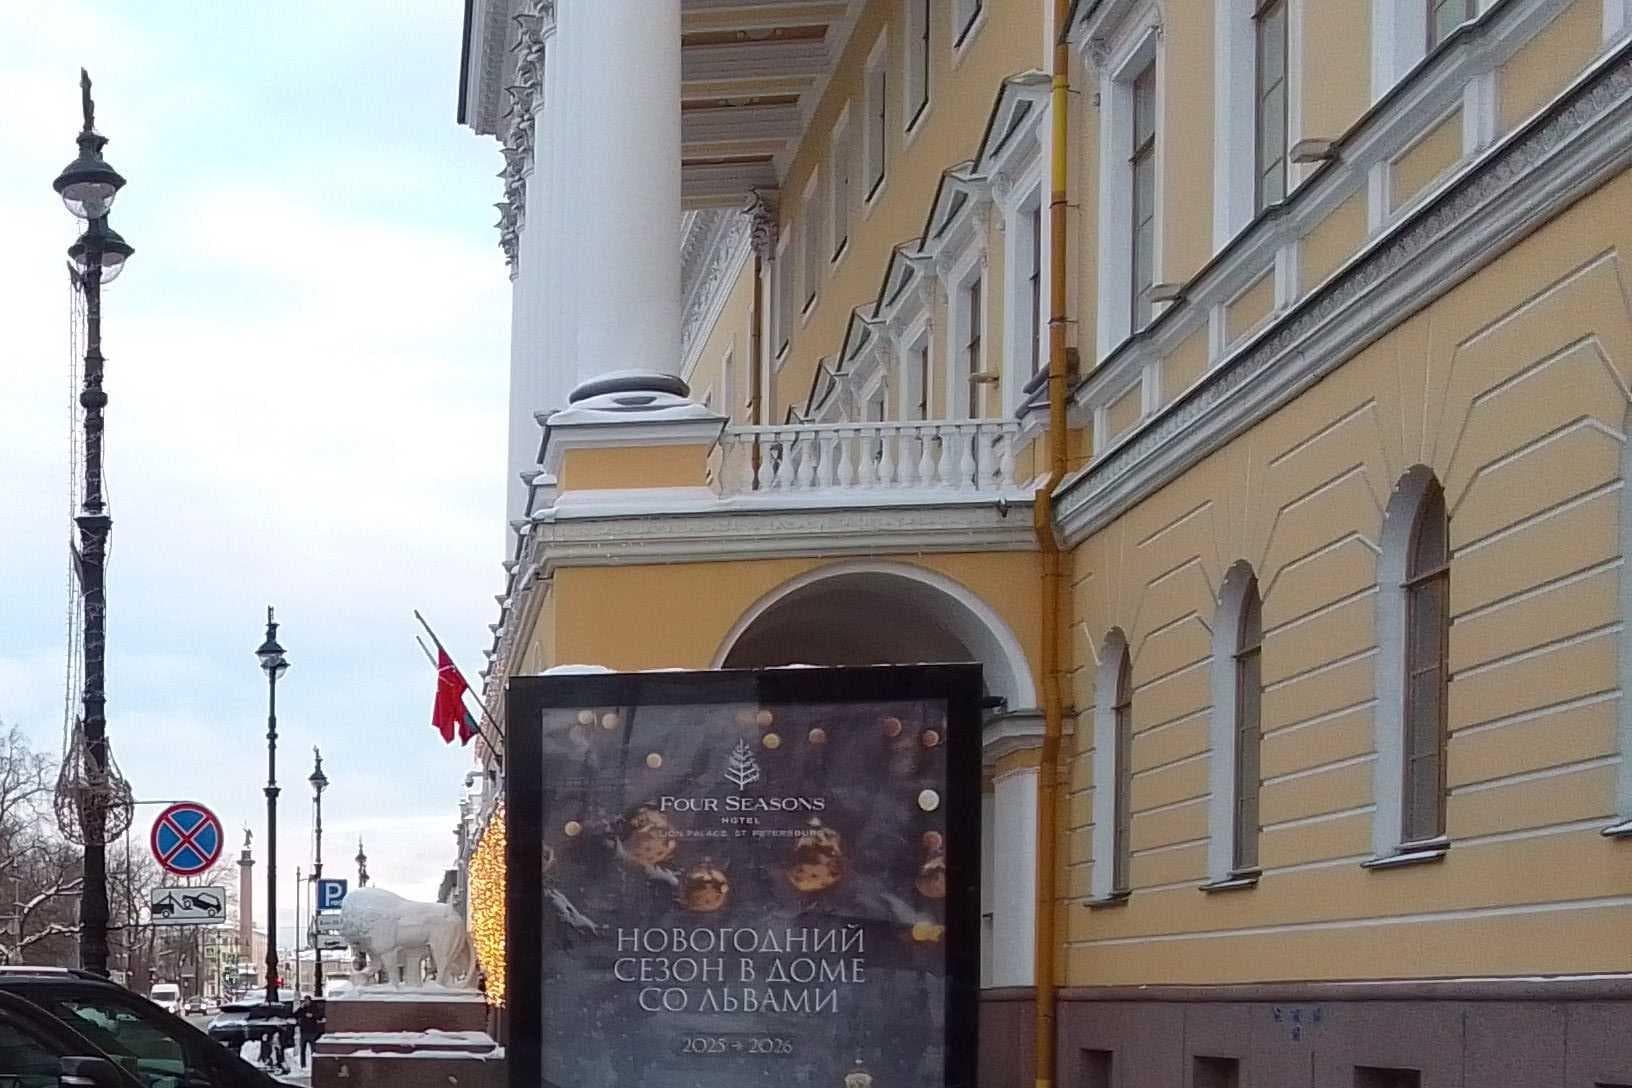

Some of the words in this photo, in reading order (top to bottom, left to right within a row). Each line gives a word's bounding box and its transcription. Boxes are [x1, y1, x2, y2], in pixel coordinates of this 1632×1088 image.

[721, 817, 761, 825] HOTEL
[325, 882, 342, 907] P
[617, 923, 866, 953] НОВОГОДНИЙ
[613, 957, 724, 982] СЕЗОН
[739, 958, 756, 982] В
[765, 957, 866, 983] ДОМЕ
[638, 987, 688, 1012] СО
[698, 987, 839, 1013] ЛЬВАМИ
